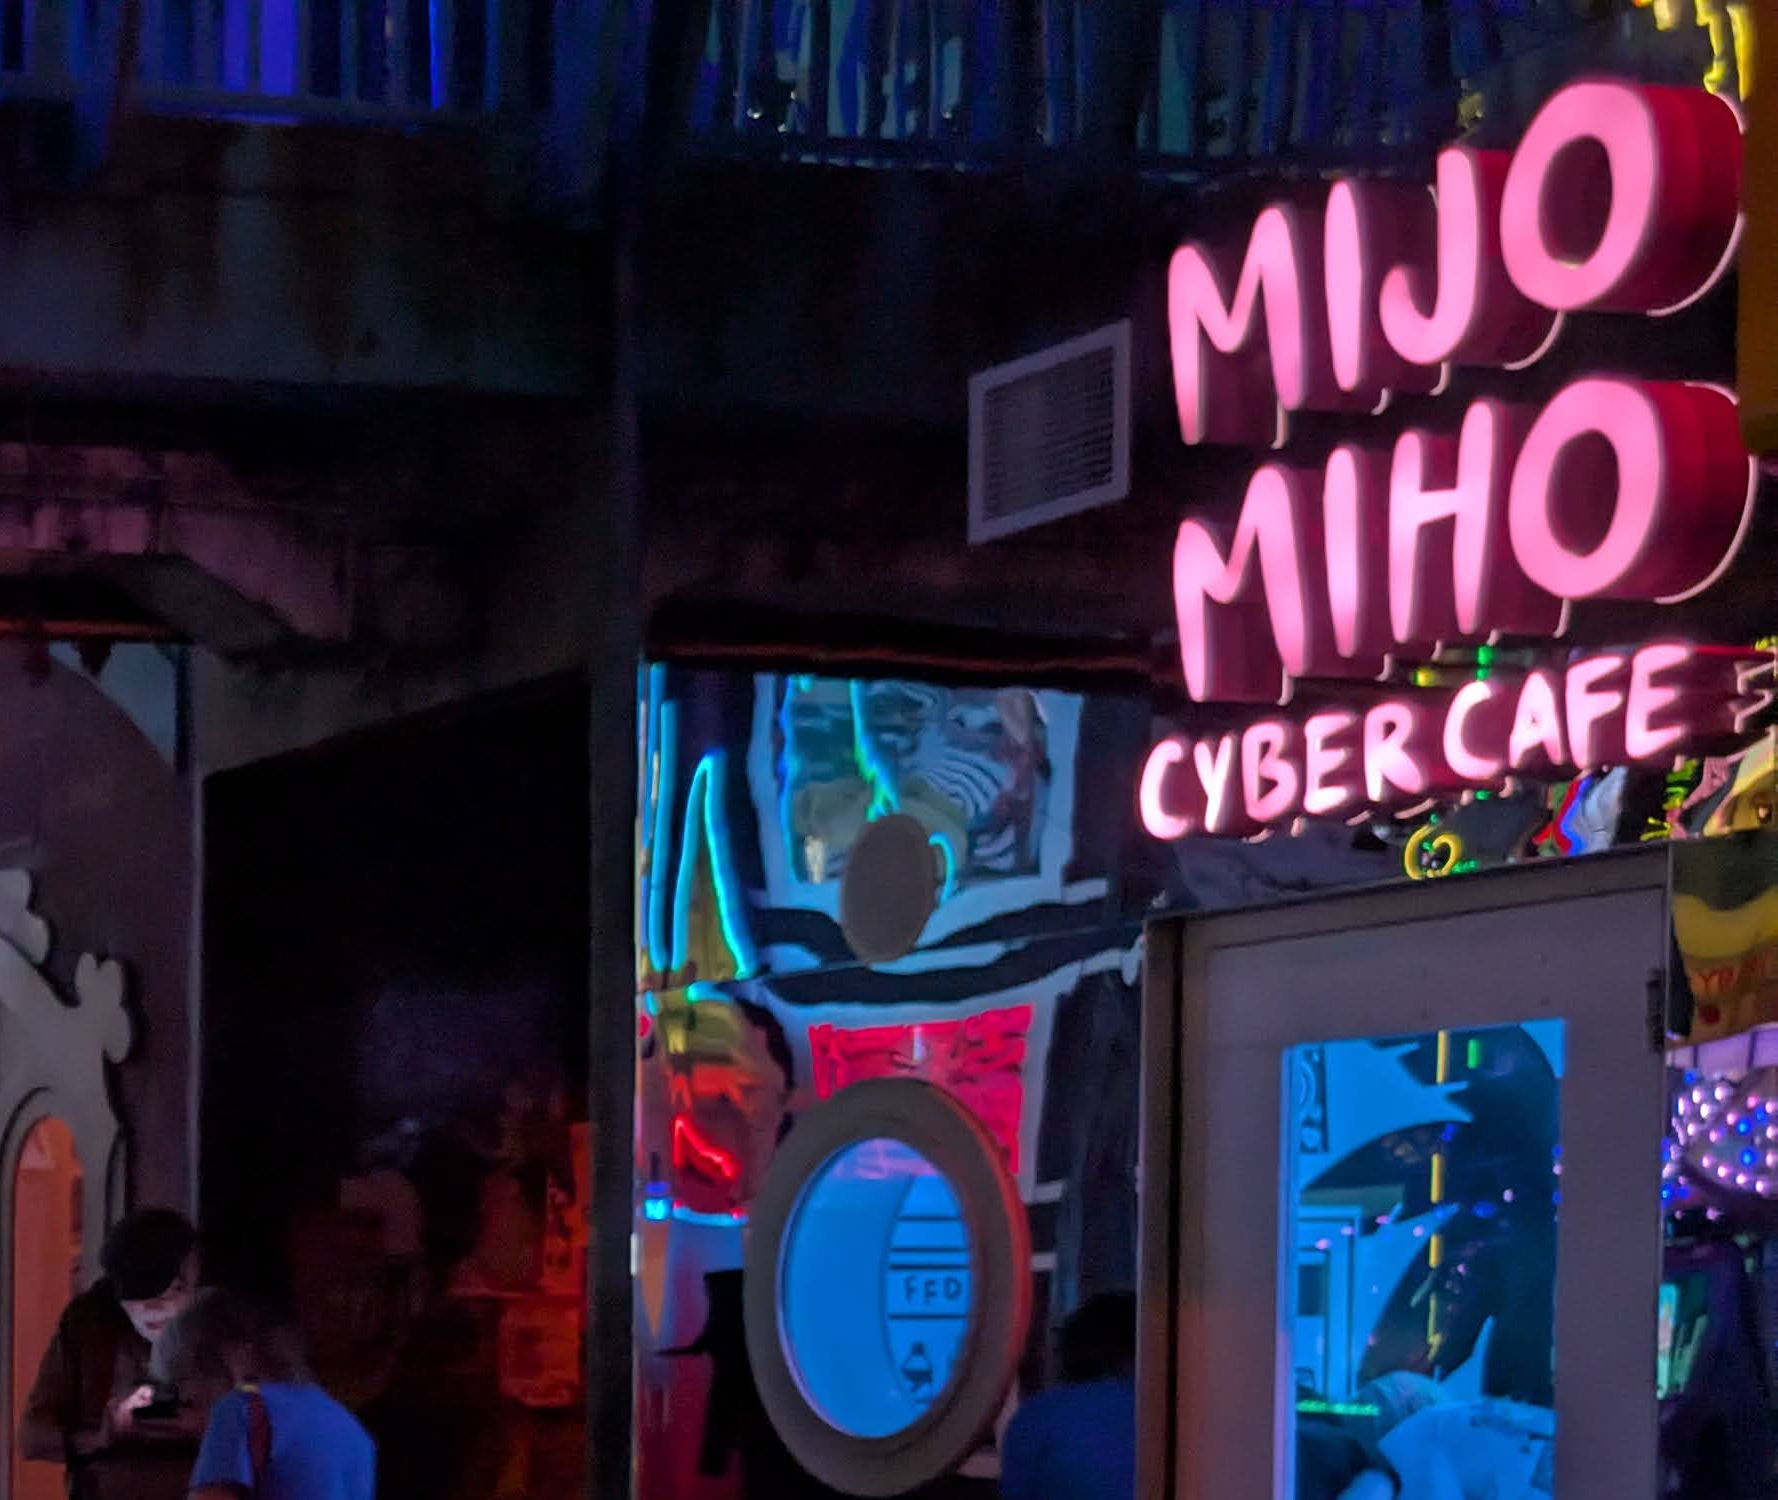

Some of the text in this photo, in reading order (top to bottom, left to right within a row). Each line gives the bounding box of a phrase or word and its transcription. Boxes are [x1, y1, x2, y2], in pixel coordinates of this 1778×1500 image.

[1167, 80, 1661, 446] MIJO
[1172, 376, 1666, 703] MIHO
[1138, 643, 1692, 842] CYBER CAFE
